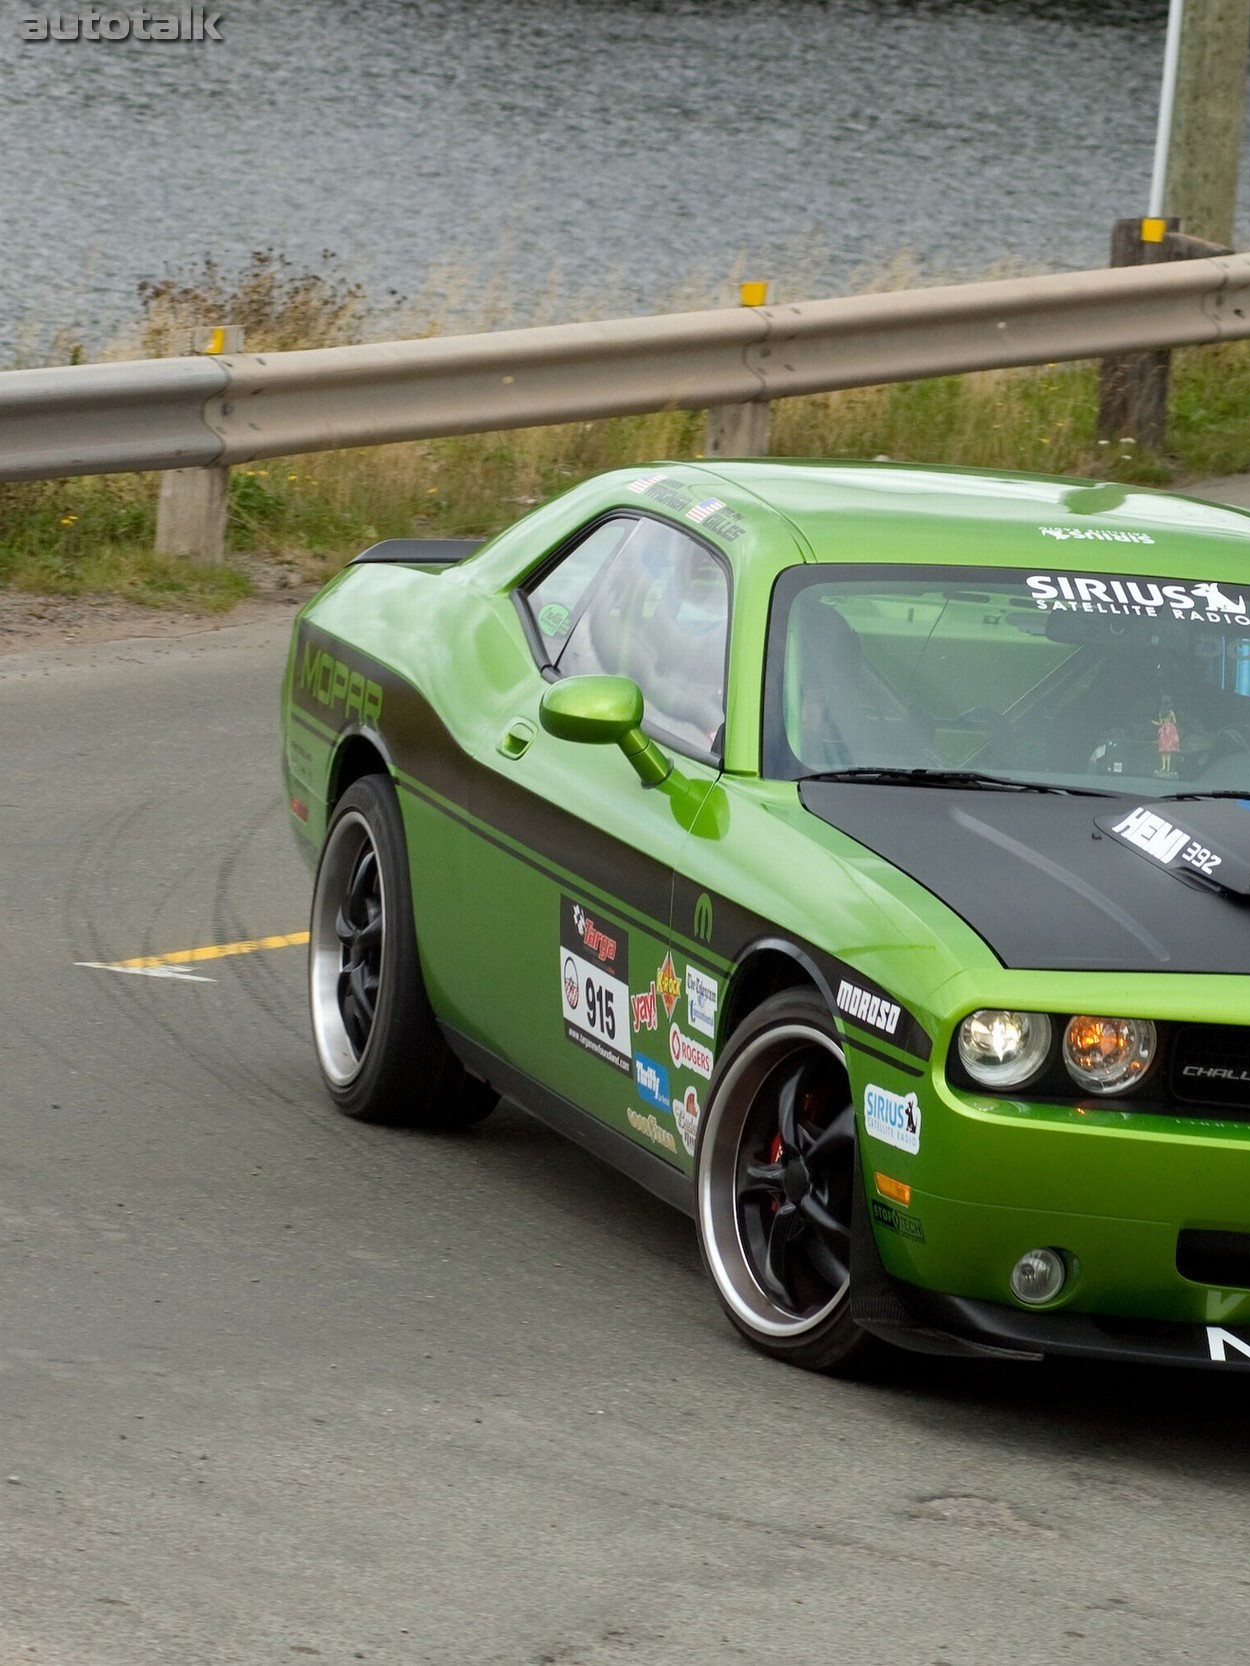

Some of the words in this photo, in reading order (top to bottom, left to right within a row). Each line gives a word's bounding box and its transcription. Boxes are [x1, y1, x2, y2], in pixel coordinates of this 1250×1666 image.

[1026, 575, 1196, 610] SIRIUS
[1036, 599, 1158, 618] SATELLITE
[301, 639, 384, 733] MOPAR
[1111, 806, 1192, 865] HEMI
[1181, 841, 1223, 875] 392
[584, 917, 617, 962] Targa
[585, 977, 617, 1041] 915
[631, 981, 658, 1033] yay!
[696, 977, 717, 1004] Telegram
[837, 979, 901, 1035] MOROSO
[681, 1041, 711, 1072] ROGERS
[635, 1059, 660, 1100] Thrifty
[867, 1091, 904, 1129] SIRIUS
[867, 1116, 894, 1139] SATELLITE
[896, 1132, 917, 1147] RADIO
